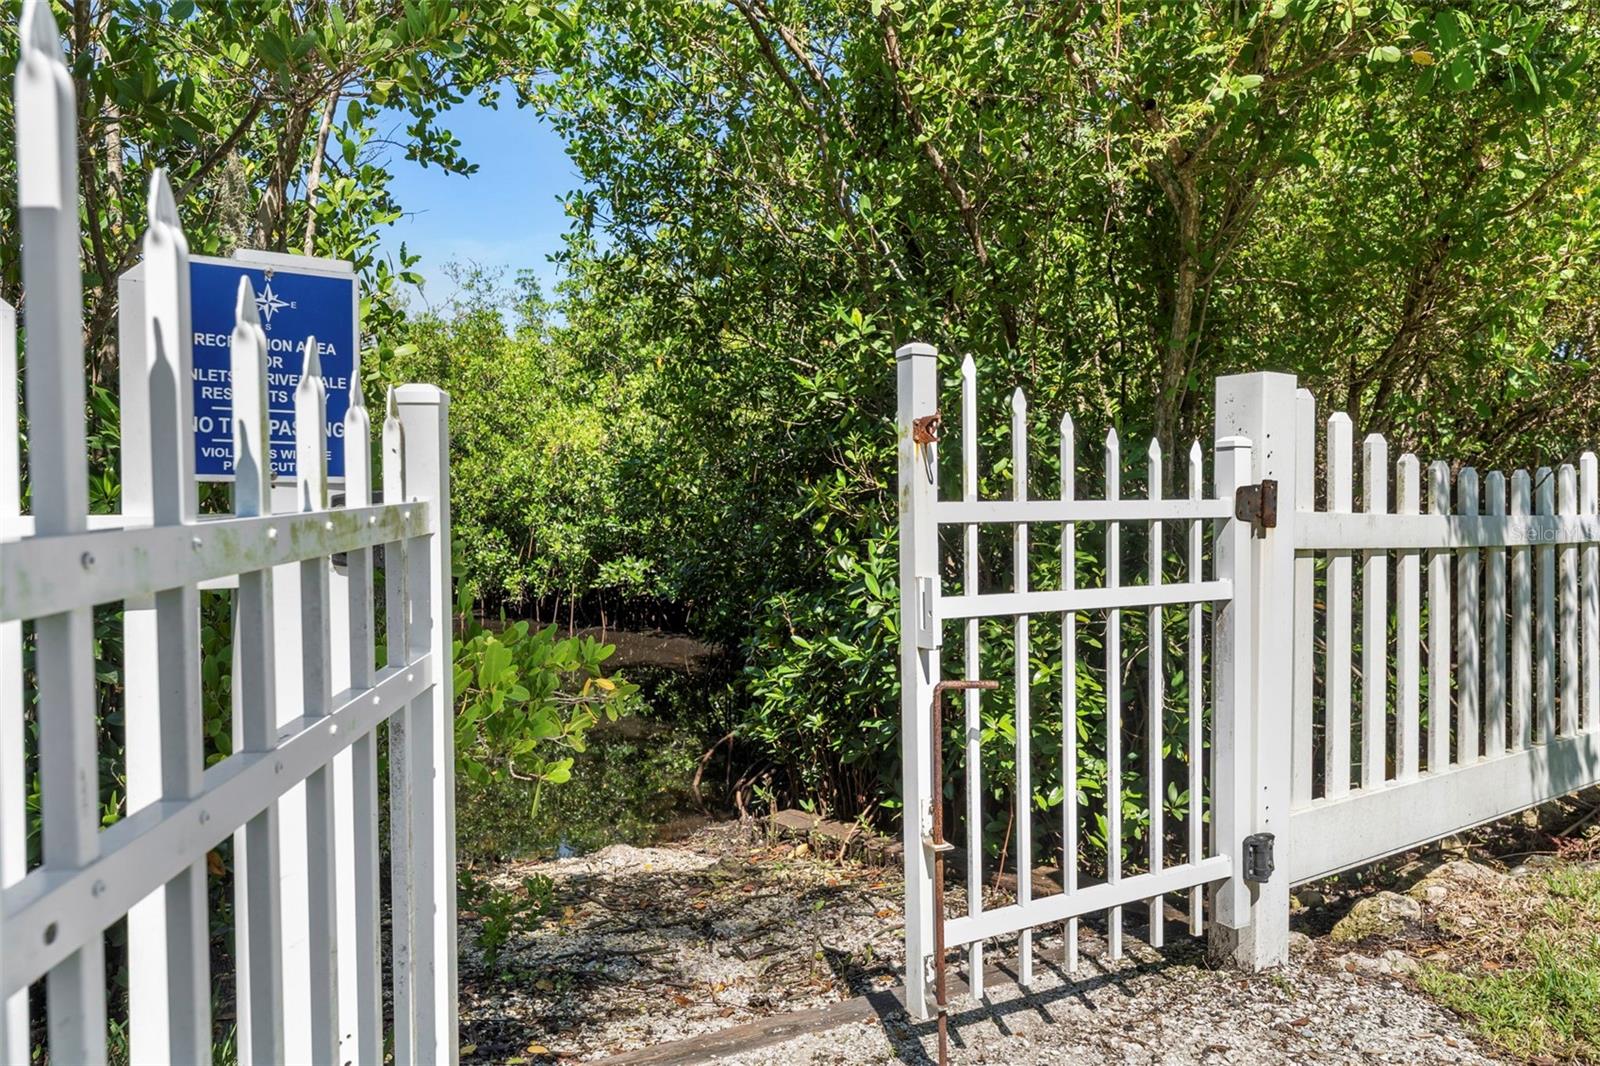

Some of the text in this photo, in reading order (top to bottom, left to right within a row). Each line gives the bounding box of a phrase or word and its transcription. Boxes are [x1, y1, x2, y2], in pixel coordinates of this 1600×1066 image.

[290, 301, 297, 309] E
[265, 323, 272, 331] S
[194, 332, 337, 356] RECION AEA
[267, 373, 347, 389] RIVEALE
[201, 386, 288, 403] RESTS
[192, 416, 214, 433] O
[201, 447, 278, 459] VIOLS
